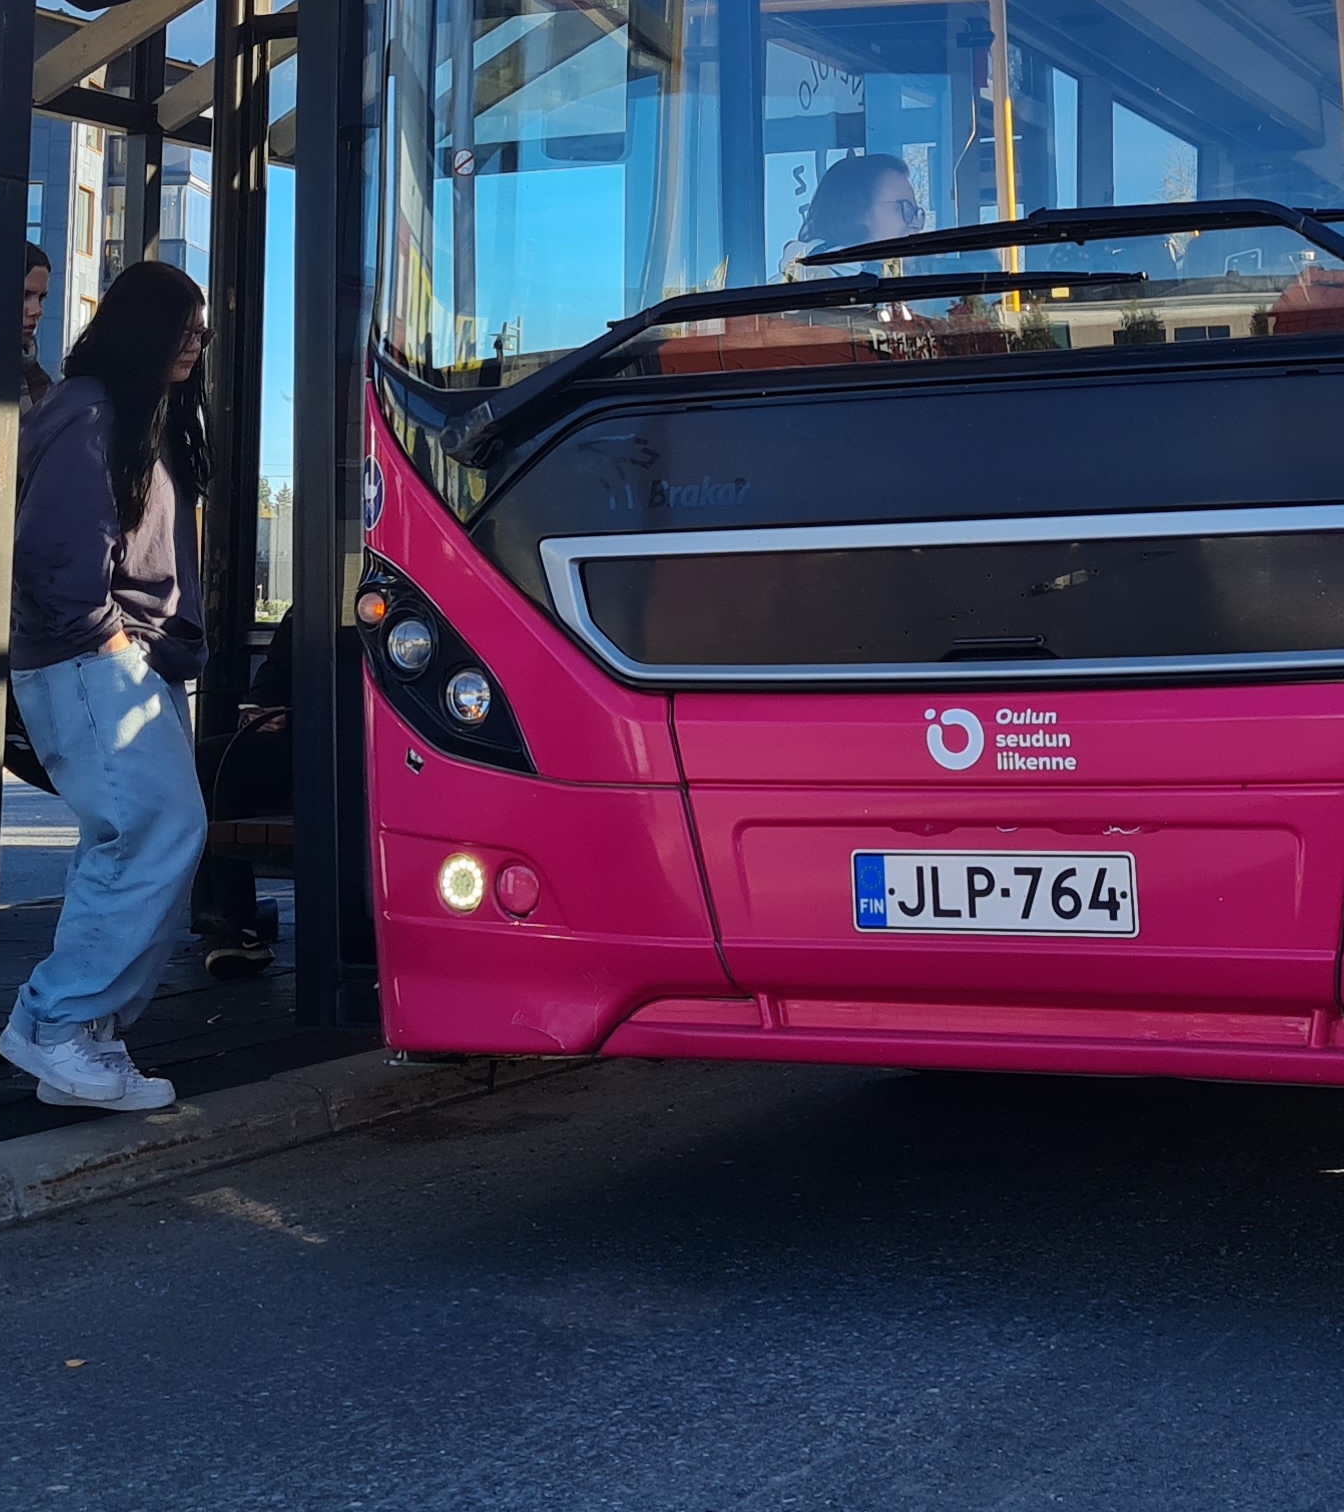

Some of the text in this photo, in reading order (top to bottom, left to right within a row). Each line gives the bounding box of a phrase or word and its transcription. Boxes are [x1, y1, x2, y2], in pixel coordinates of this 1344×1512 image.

[647, 475, 753, 509] Brakar
[995, 707, 1057, 725] Oulun
[995, 729, 1071, 748] seudun
[996, 752, 1077, 771] liikenne
[897, 865, 1121, 921] JLP-764
[859, 898, 884, 914] FIN
